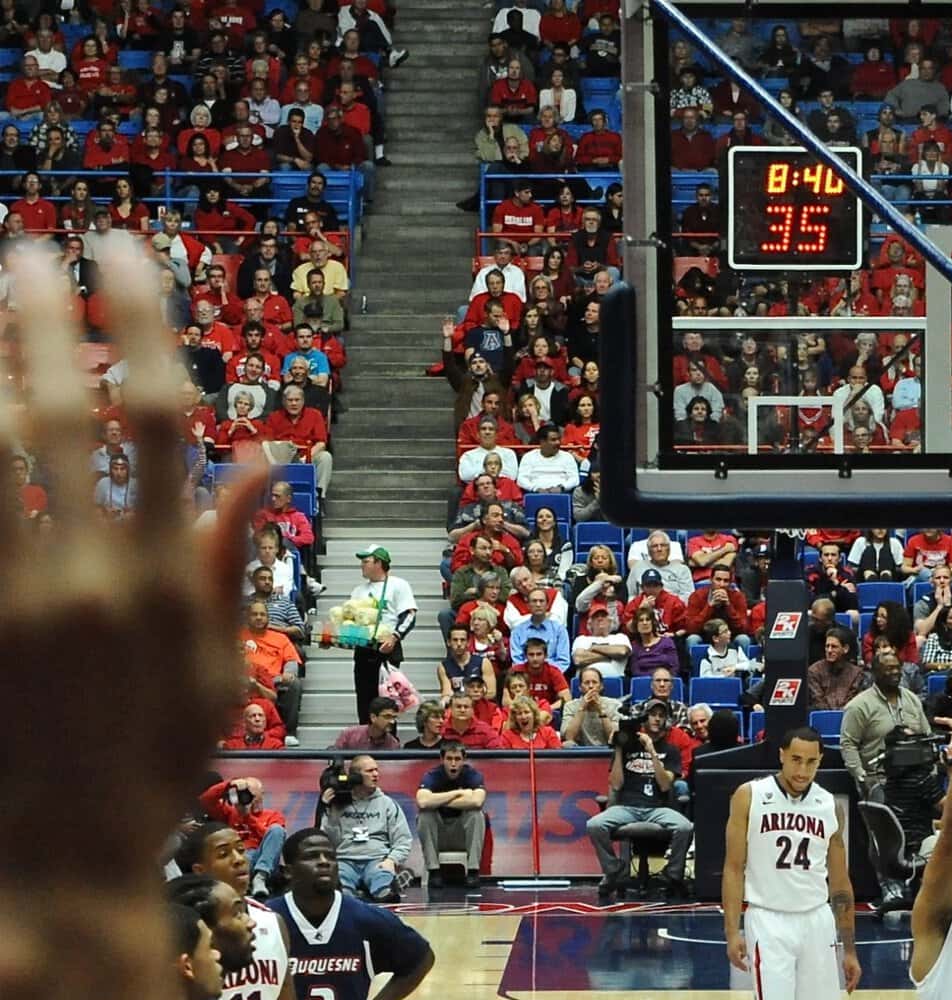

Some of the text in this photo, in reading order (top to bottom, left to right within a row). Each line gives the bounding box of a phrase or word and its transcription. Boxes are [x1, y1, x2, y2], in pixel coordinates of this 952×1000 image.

[761, 206, 830, 251] 35
[760, 812, 824, 839] ARIZONA
[776, 836, 811, 870] 24
